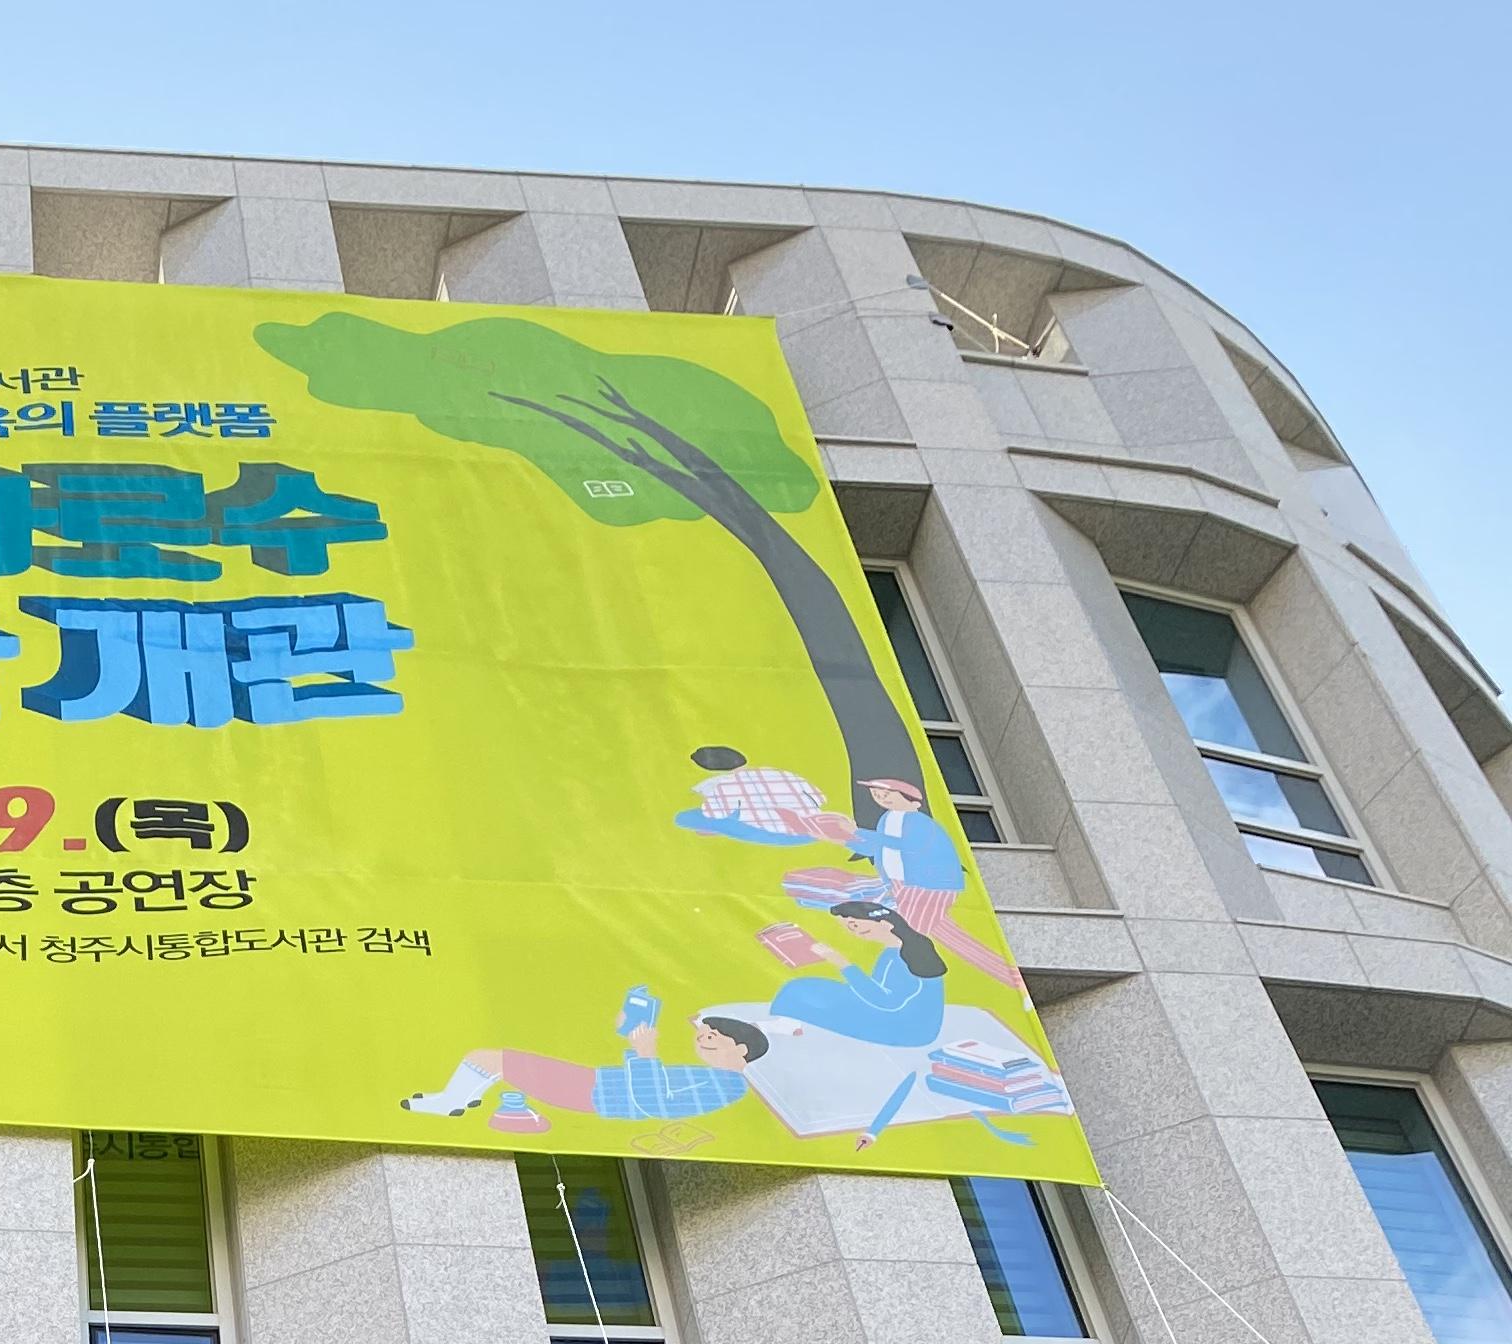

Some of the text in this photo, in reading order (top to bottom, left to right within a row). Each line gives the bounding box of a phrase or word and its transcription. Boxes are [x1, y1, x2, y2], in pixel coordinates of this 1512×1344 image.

[88, 402, 276, 439] 플랫폼
[19, 592, 414, 730] 개관
[54, 866, 256, 914] 공연장
[38, 928, 347, 963] 청주시통합도서관
[355, 926, 433, 958] 검색
